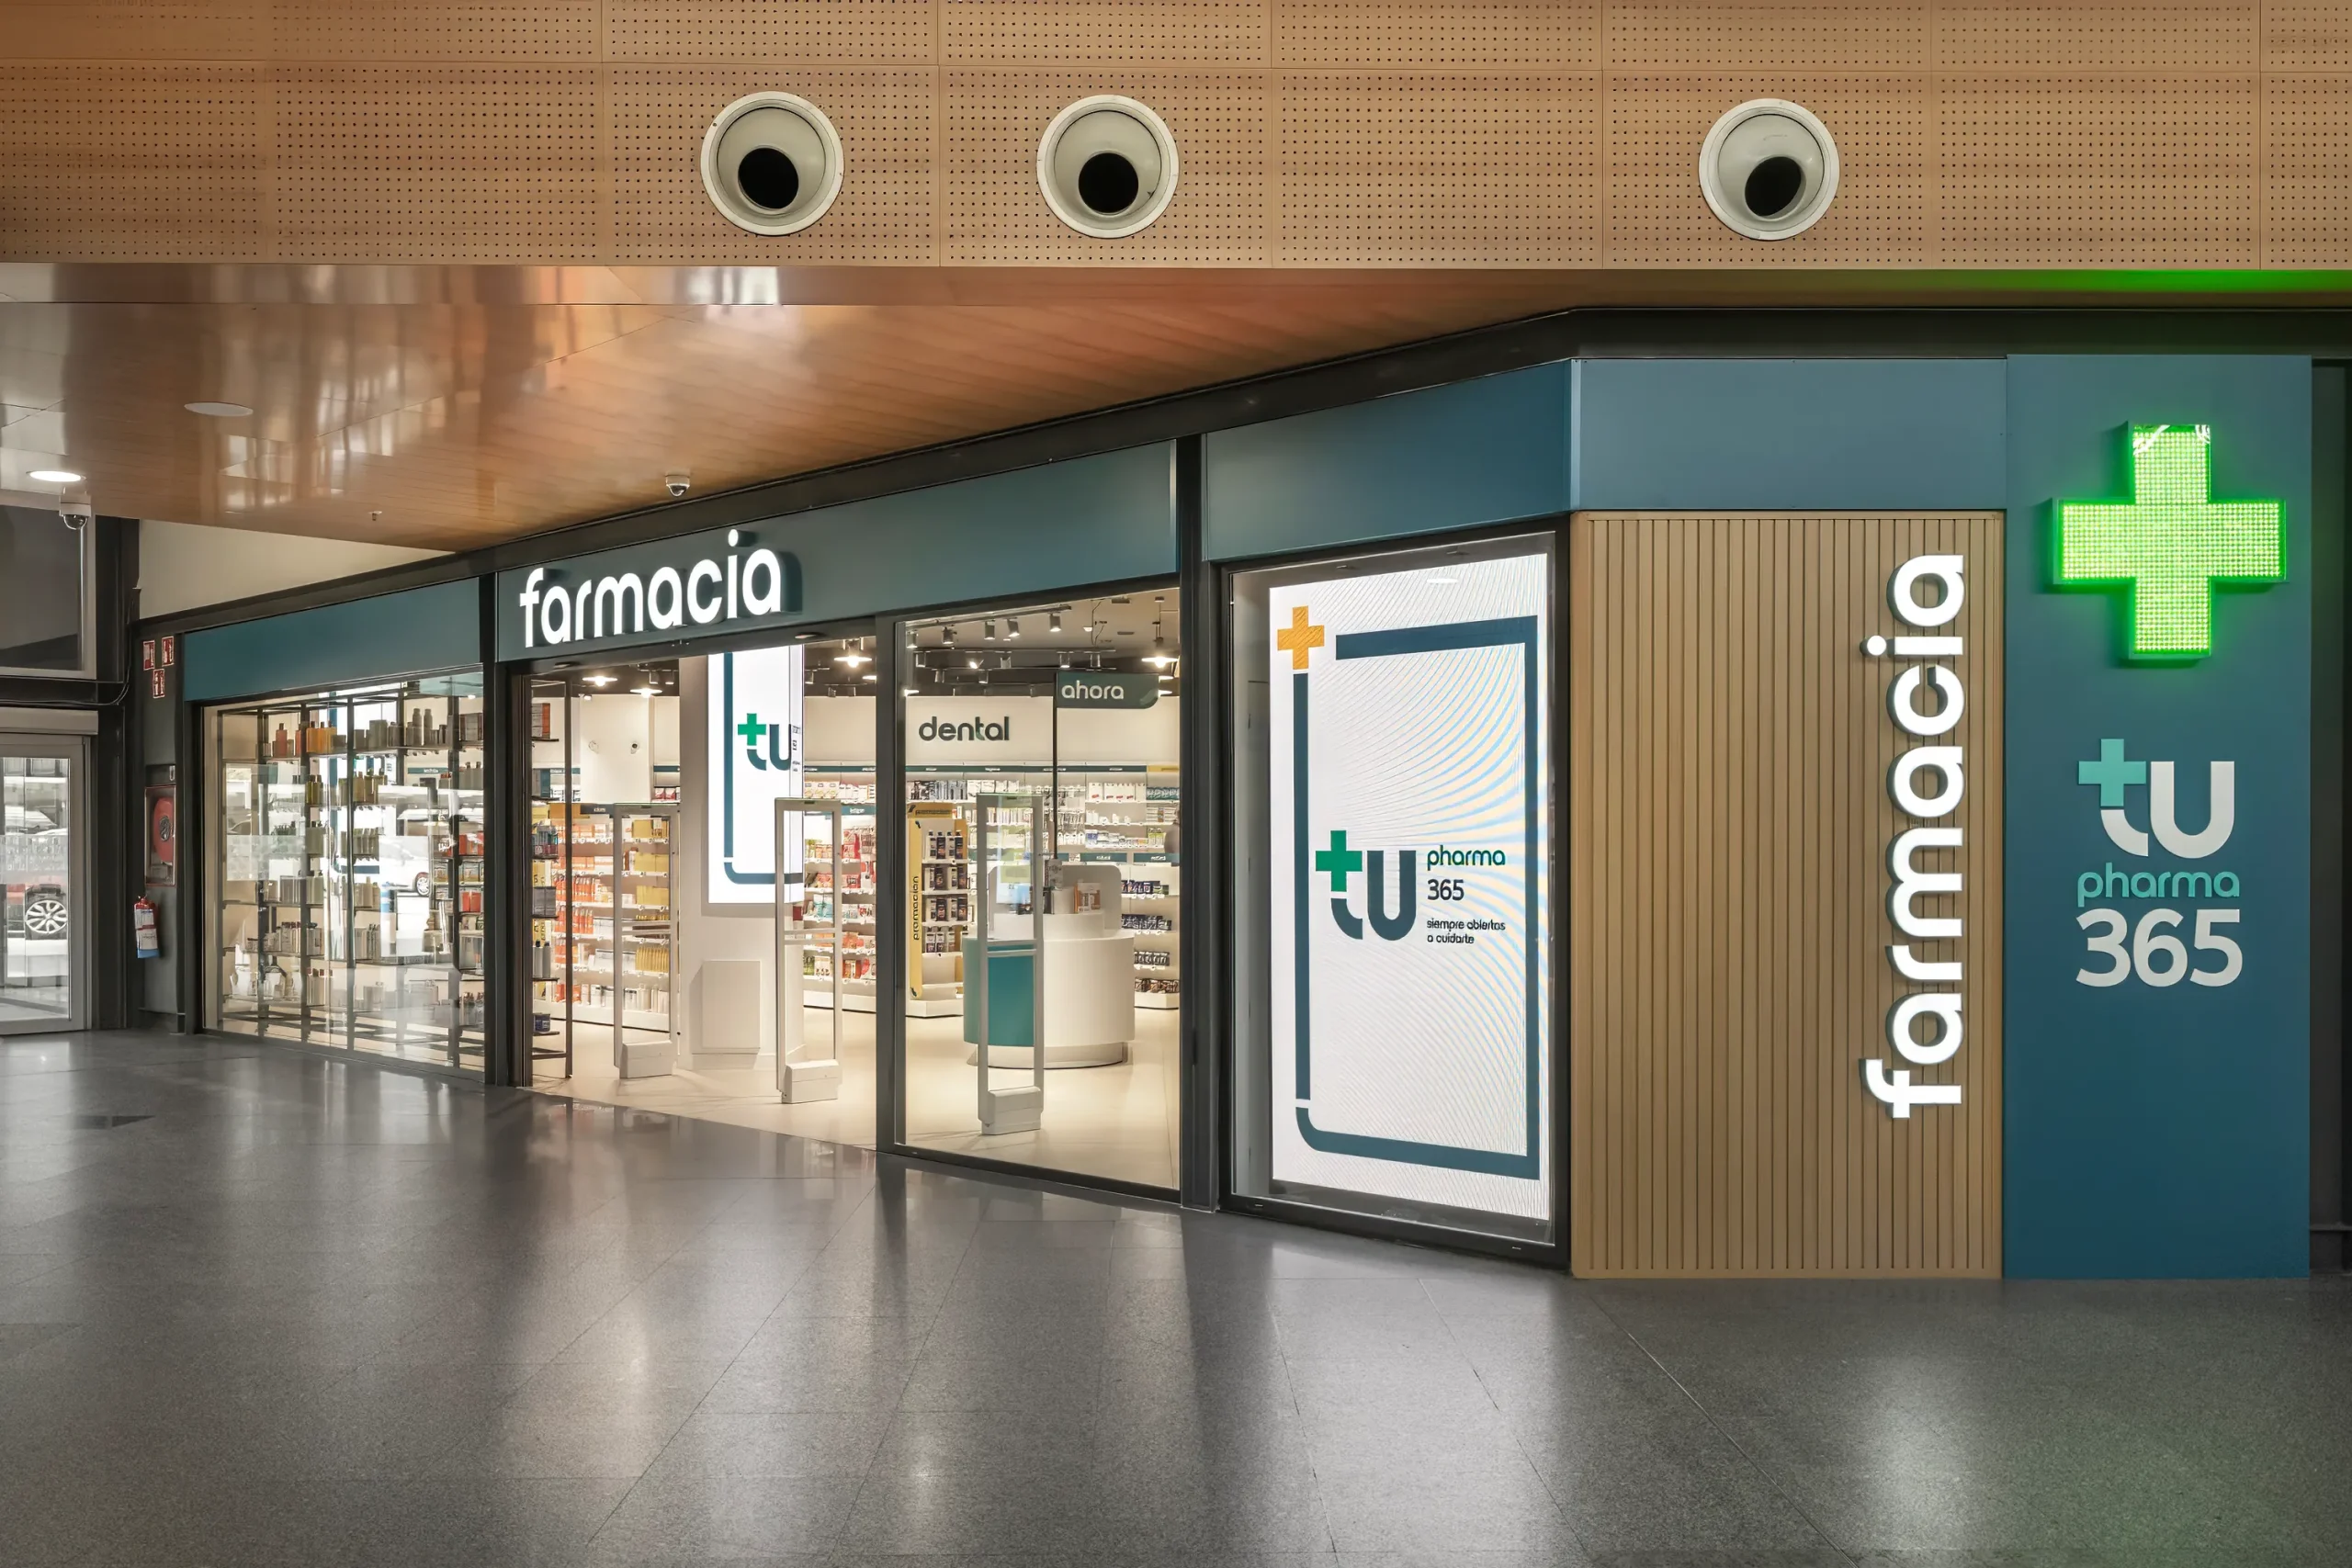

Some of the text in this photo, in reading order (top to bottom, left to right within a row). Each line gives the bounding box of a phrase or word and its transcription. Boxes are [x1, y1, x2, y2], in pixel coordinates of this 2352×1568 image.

[519, 528, 783, 649] farmacia
[1061, 680, 1125, 700] ahora
[919, 716, 1010, 741] dental
[2077, 738, 2235, 859] tu
[1862, 554, 1965, 1120] farmacia
[1427, 845, 1506, 871] pharma
[1316, 830, 1417, 942] tu
[1427, 879, 1464, 901] 365
[2077, 862, 2240, 908] pharma
[1427, 919, 1464, 932] siempre
[1436, 932, 1475, 943] cuidarte
[2075, 908, 2243, 987] 365
